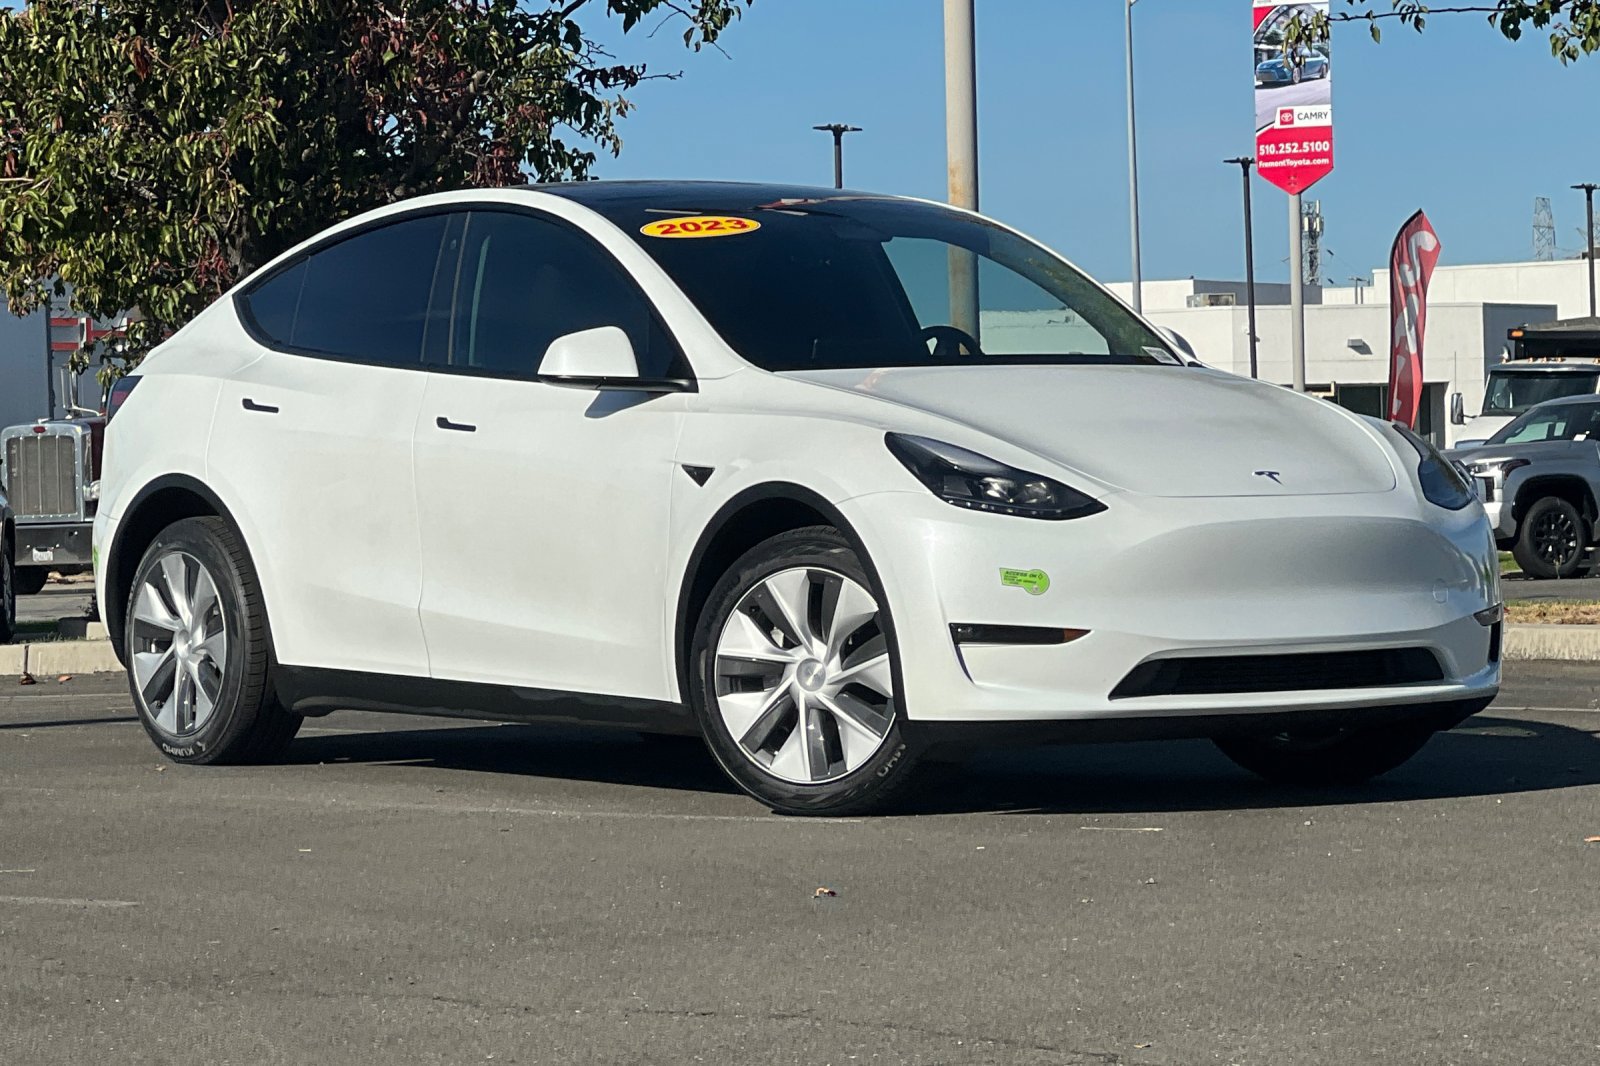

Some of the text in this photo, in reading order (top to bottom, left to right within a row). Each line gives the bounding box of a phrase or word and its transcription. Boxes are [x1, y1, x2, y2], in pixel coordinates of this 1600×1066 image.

[1297, 111, 1329, 121] CAMRY
[1259, 141, 1330, 155] 510.252.5100
[1258, 158, 1330, 168] FremontToyota.com
[656, 219, 750, 235] 2023
